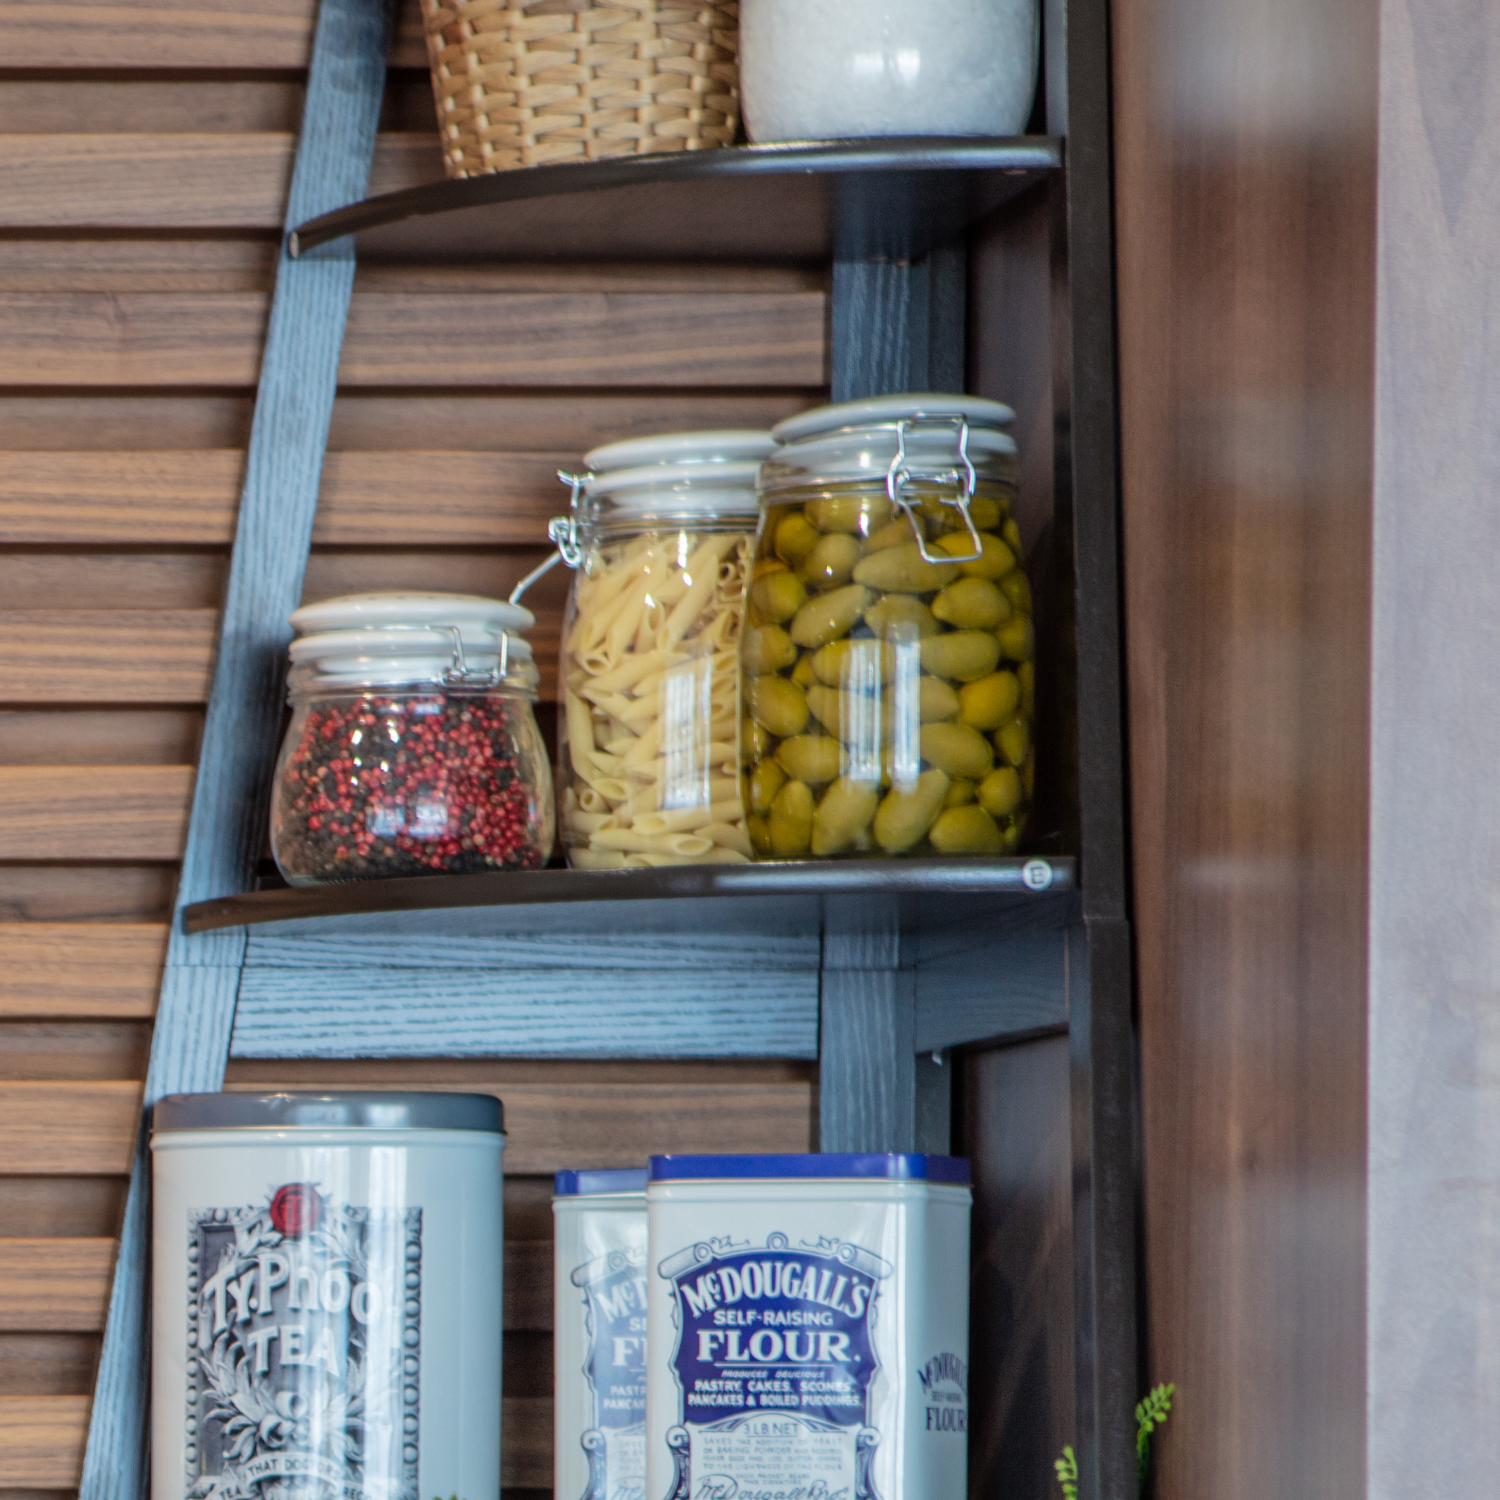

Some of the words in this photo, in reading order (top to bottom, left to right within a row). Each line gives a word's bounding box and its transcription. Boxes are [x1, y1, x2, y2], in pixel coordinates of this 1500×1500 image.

[1030, 866, 1044, 884] E
[680, 1261, 870, 1319] McDOUGALL'S
[713, 1309, 834, 1326] SELF-RAISING
[248, 1325, 340, 1377] TEA
[721, 1369, 769, 1379] PRODUCES
[775, 1369, 826, 1379] DELICIOUS
[687, 1393, 744, 1406] PANCAKES
[759, 1394, 799, 1407] BOILED
[772, 1422, 799, 1435] NET
[219, 1486, 242, 1499] TEA
[249, 1458, 278, 1476] THAT
[285, 1459, 343, 1480] DOCORS
